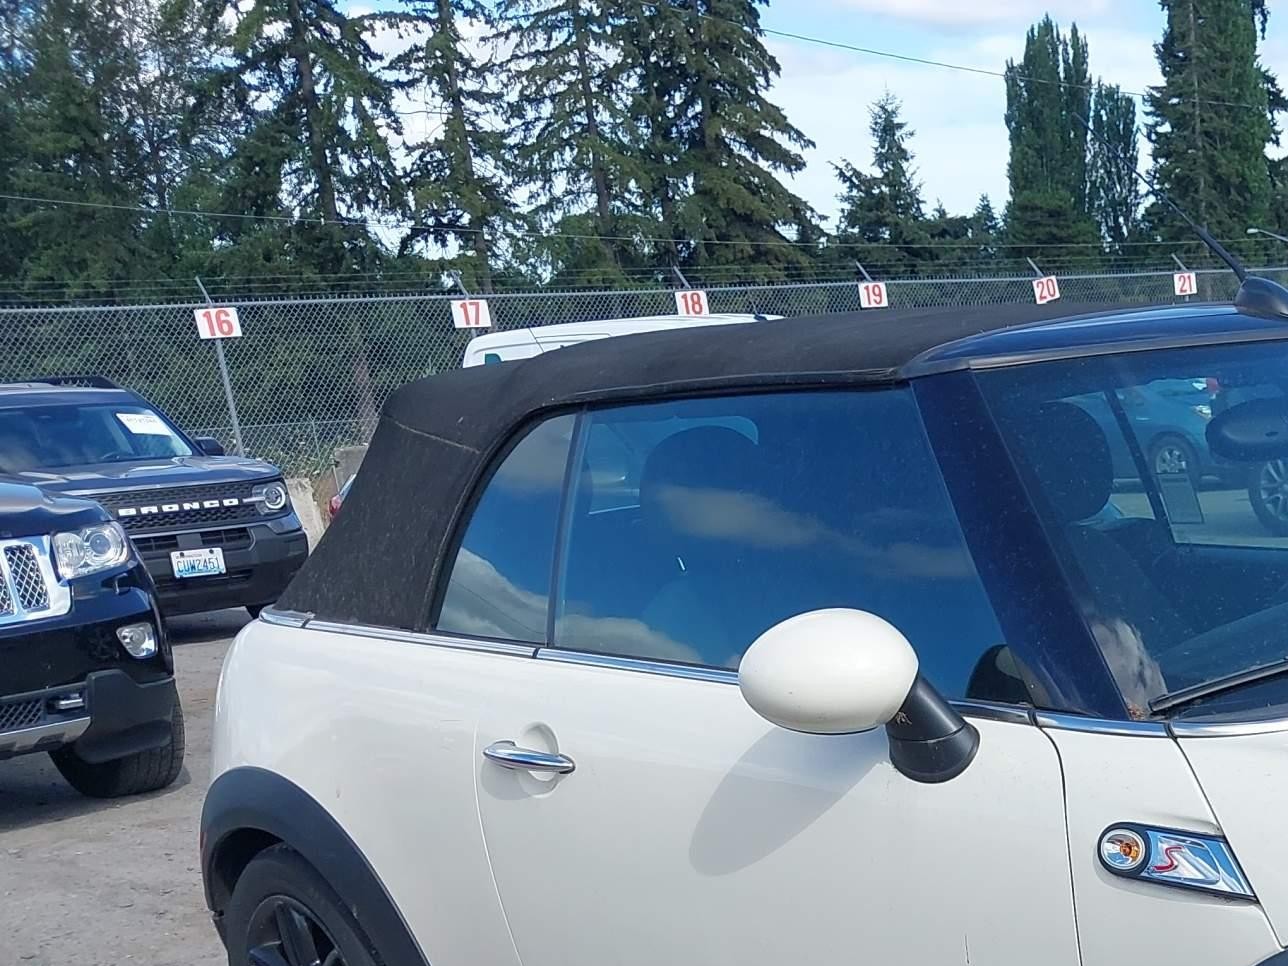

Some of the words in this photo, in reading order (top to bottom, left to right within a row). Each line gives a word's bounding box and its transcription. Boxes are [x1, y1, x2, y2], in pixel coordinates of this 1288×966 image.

[863, 284, 884, 306] 19
[1036, 278, 1057, 301] 20
[1178, 275, 1193, 294] 21
[459, 301, 481, 327] 17
[681, 292, 704, 316] 18
[202, 309, 234, 337] 16
[118, 498, 239, 516] BRONCO
